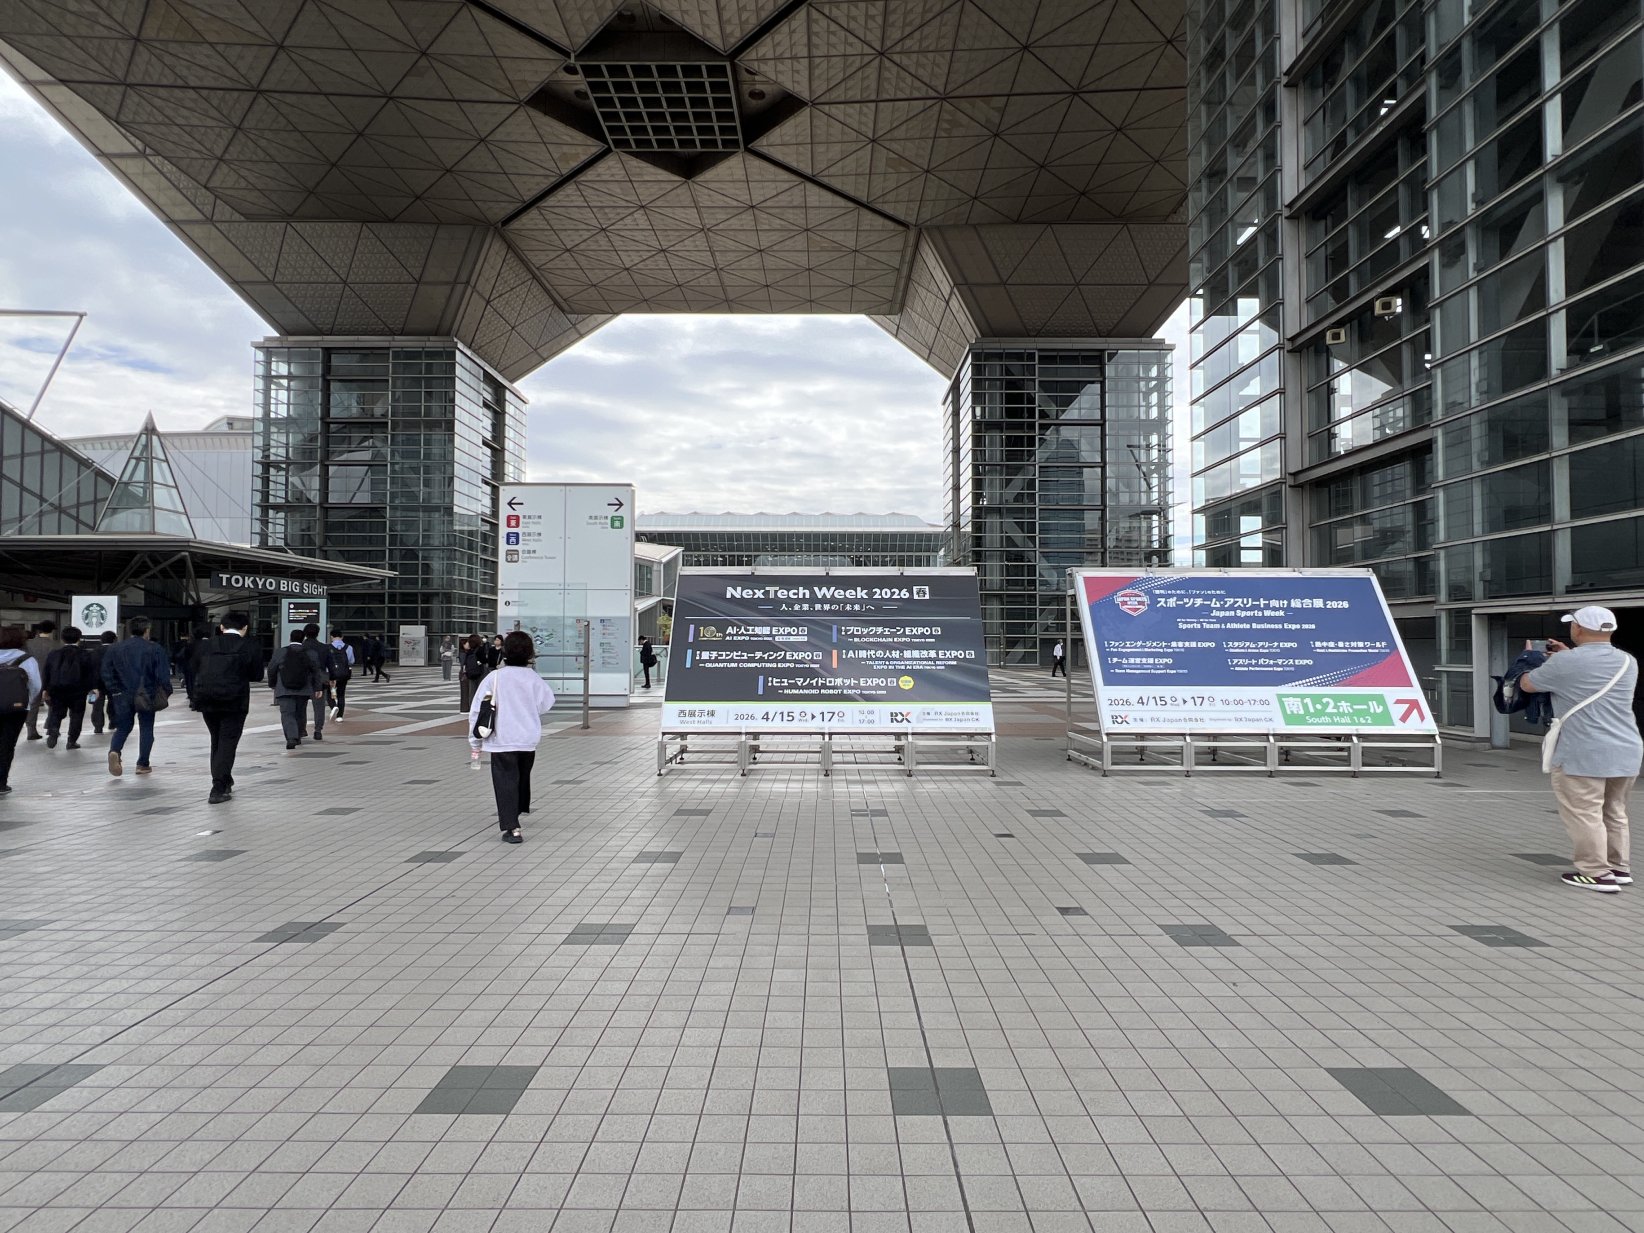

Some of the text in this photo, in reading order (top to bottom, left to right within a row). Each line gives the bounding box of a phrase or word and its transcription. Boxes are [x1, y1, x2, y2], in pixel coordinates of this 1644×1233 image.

[219, 574, 327, 595] TOKYO BIG SIGHT
[726, 587, 909, 599] NexTech Week 2026
[914, 587, 928, 599] 春
[1157, 598, 1288, 608] スポーツチーム・アスリート向け
[1291, 598, 1324, 608] 総合展
[846, 626, 904, 635] ブロックチェーン
[773, 677, 858, 686] ヒューマノイドロボット
[860, 678, 886, 686] EXPO
[1136, 696, 1167, 706] 4/15
[1191, 696, 1205, 706] 17
[1282, 697, 1383, 714] 南1・2ホール
[678, 710, 716, 718] 西展示棟
[761, 712, 795, 722] 4/15
[820, 712, 835, 722] 17
[890, 712, 911, 723] RX
[1112, 714, 1130, 724] RX
